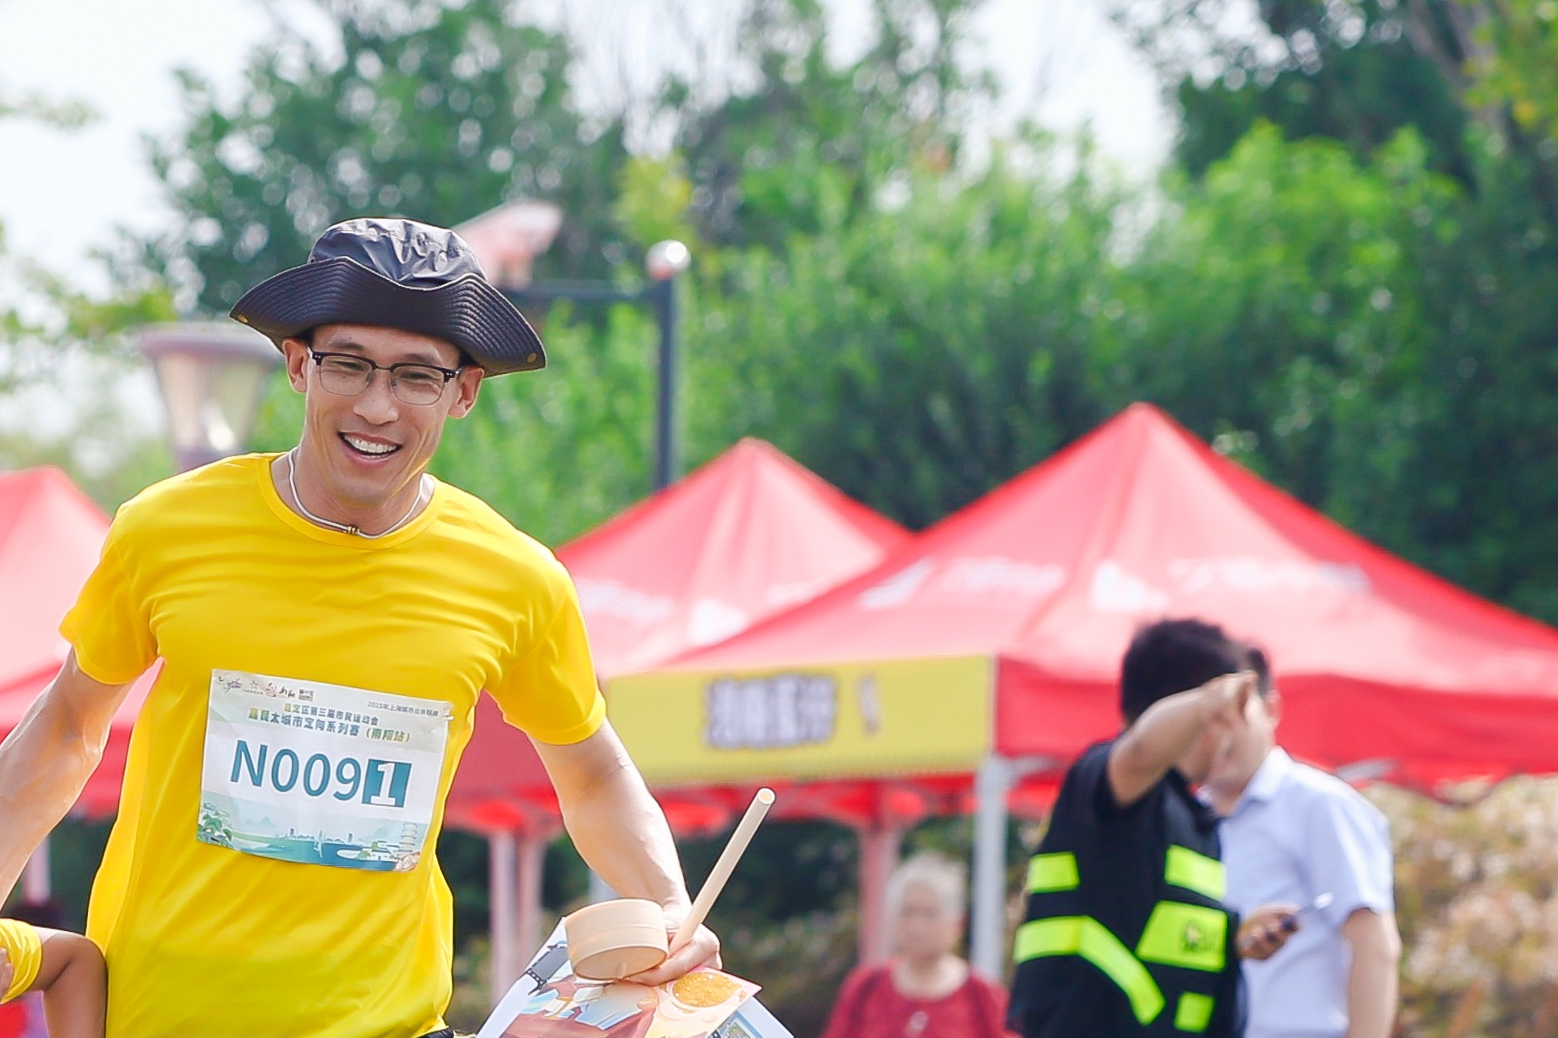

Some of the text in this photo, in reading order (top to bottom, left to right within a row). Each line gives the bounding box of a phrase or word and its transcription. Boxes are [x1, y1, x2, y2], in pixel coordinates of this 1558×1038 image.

[283, 703, 380, 726] 嘉定区第三届市民运动会
[230, 739, 406, 806] N0091
